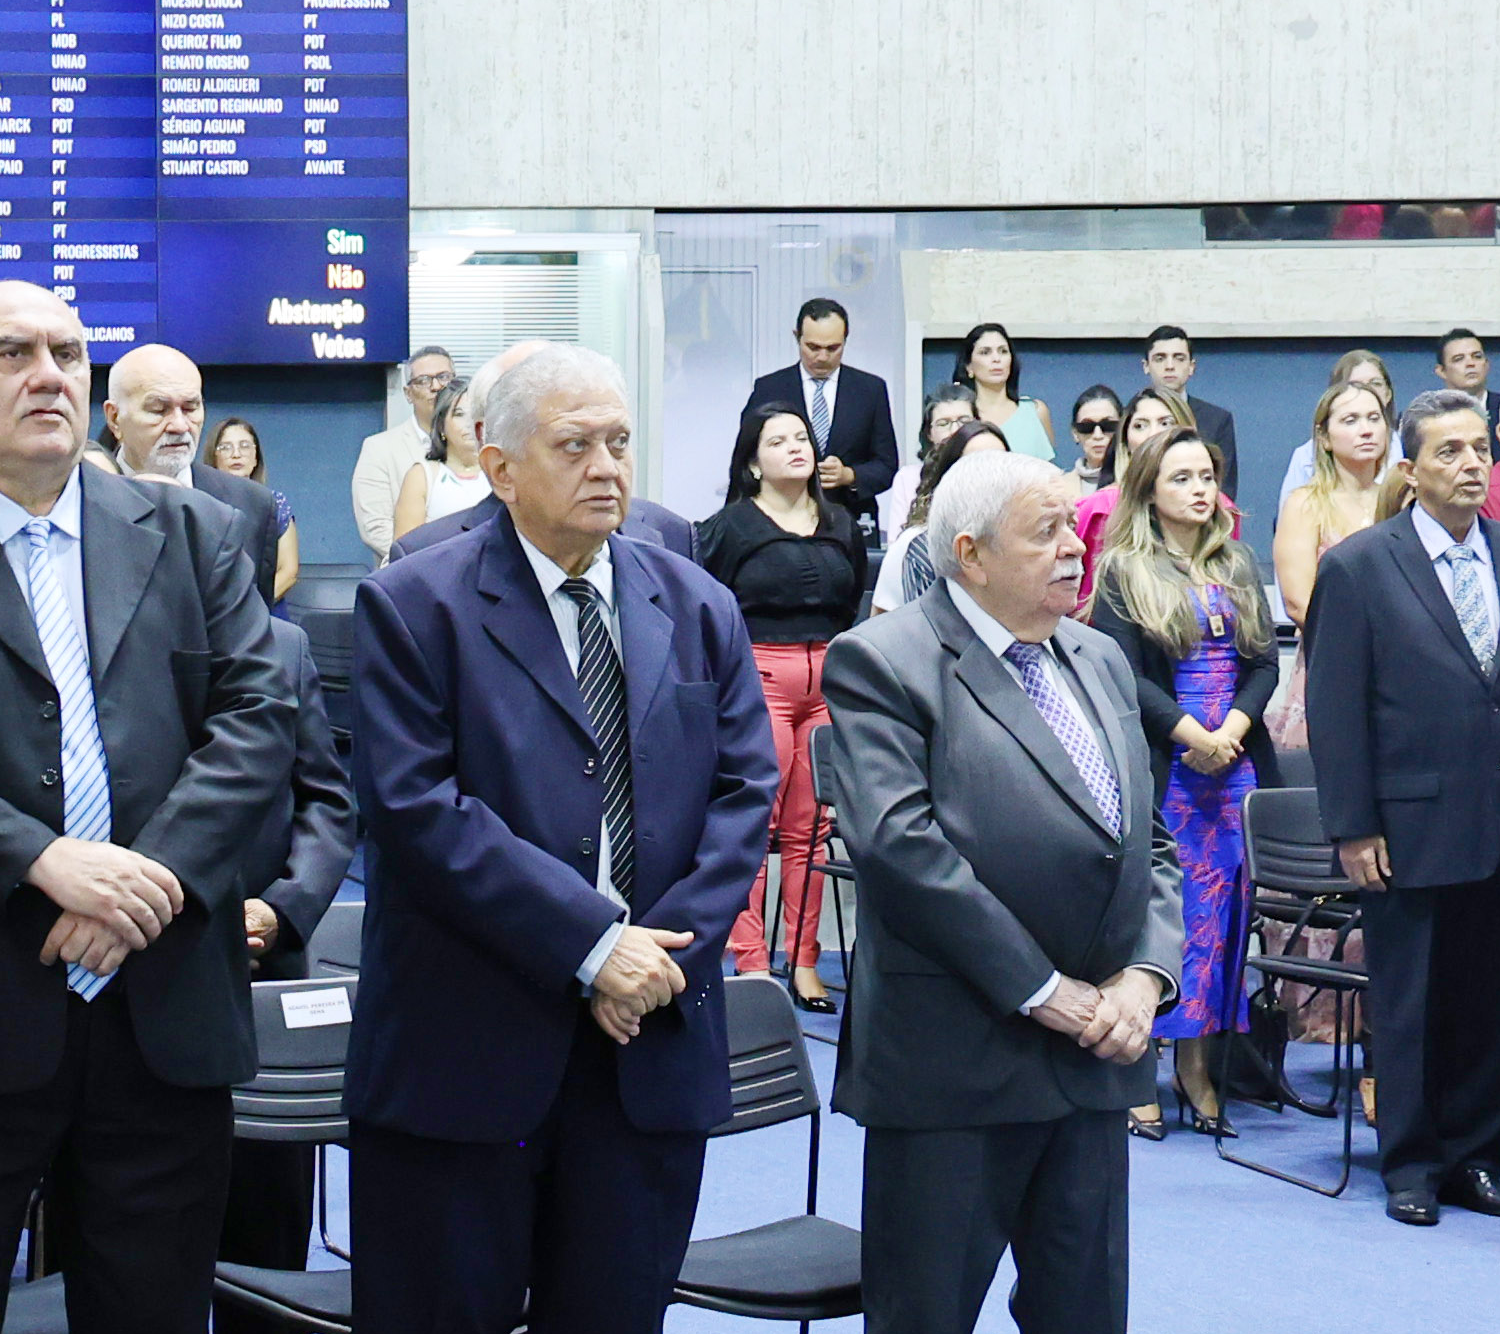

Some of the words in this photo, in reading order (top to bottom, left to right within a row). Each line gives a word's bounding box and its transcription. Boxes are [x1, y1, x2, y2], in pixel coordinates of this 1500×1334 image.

[51, 13, 65, 28] PL
[189, 14, 224, 29] COSTA
[304, 14, 318, 29] PT
[52, 34, 77, 49] MDB
[162, 35, 209, 50] QUEIROZ
[210, 35, 242, 49] FILHO
[304, 35, 325, 49] PDT
[52, 55, 86, 69] UNIAO
[162, 55, 204, 70] RENATO
[206, 55, 249, 70] ROSENO
[304, 55, 332, 70] PSOL
[52, 78, 86, 92] UNIAO
[162, 78, 201, 93] ROMEU
[203, 78, 260, 93] ALDIGUERI
[304, 78, 325, 93] PDT
[52, 98, 74, 113] PSD
[162, 99, 219, 113] SARGENTO
[221, 99, 283, 113] REGINAURO
[304, 99, 339, 113] UNIAO
[52, 119, 73, 134] PDT
[162, 116, 202, 134] SÉRGIO
[204, 119, 245, 134] AGUIAR
[304, 119, 325, 134] PDT
[52, 139, 73, 154] PDT
[162, 139, 198, 154] SIMÃO
[200, 140, 236, 154] PEDRO
[304, 140, 327, 154] PSD
[52, 160, 66, 175] PT
[162, 160, 203, 175] STUART
[205, 160, 249, 175] CASTRO
[305, 160, 345, 175] AVANTE
[52, 180, 66, 195] PT
[53, 201, 67, 216] PT
[53, 224, 67, 238] PT
[327, 228, 364, 255] Sim
[53, 245, 138, 259] PROGRESSISTAS
[54, 265, 75, 280] PDT
[327, 264, 364, 289] Não
[268, 298, 364, 329] Abstenção
[312, 332, 365, 359] Votos
